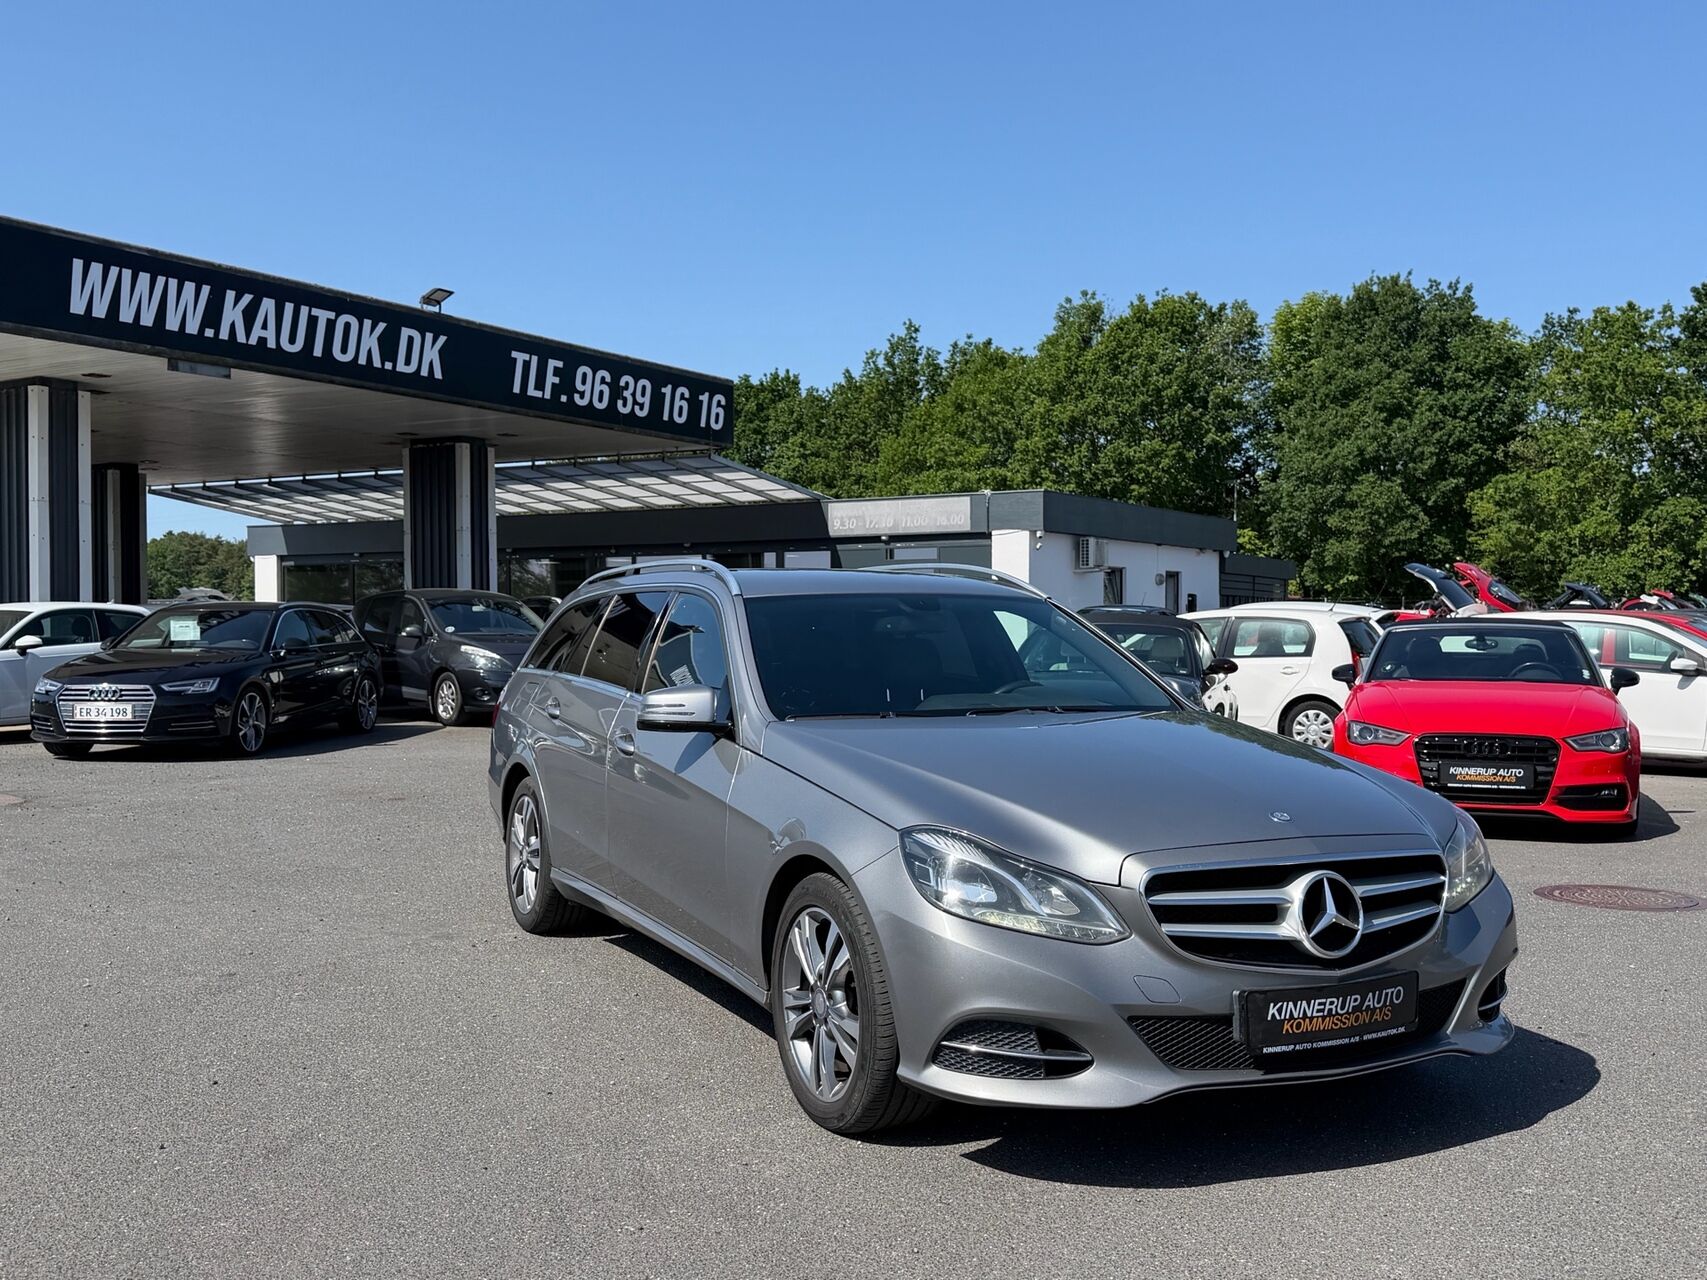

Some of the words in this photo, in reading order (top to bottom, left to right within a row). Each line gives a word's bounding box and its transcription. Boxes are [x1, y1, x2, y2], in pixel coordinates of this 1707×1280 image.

[69, 258, 448, 380] WWW.KAUTOK.DK
[511, 350, 567, 403] TLF.
[573, 365, 611, 410] 96
[617, 375, 652, 417] 39
[661, 384, 690, 424] 16
[699, 391, 726, 431] 16
[833, 518, 857, 530] 9.30
[79, 708, 92, 717] ER
[94, 707, 107, 717] 34
[110, 707, 128, 717] 198
[1449, 766, 1497, 775] KINNERUP
[1497, 768, 1524, 777] AUTO
[1456, 774, 1503, 783] KOMMISSION
[1267, 995, 1361, 1020] KINNERUP
[1362, 986, 1404, 1010] AUTO
[1282, 1012, 1371, 1034] KOMMISSION
[1371, 1006, 1392, 1021] A/S
[1262, 1045, 1295, 1054] KINNERUP
[1295, 1043, 1312, 1051] AUTO
[1312, 1038, 1350, 1049] KOMMISSION
[1350, 1036, 1360, 1044] A/S
